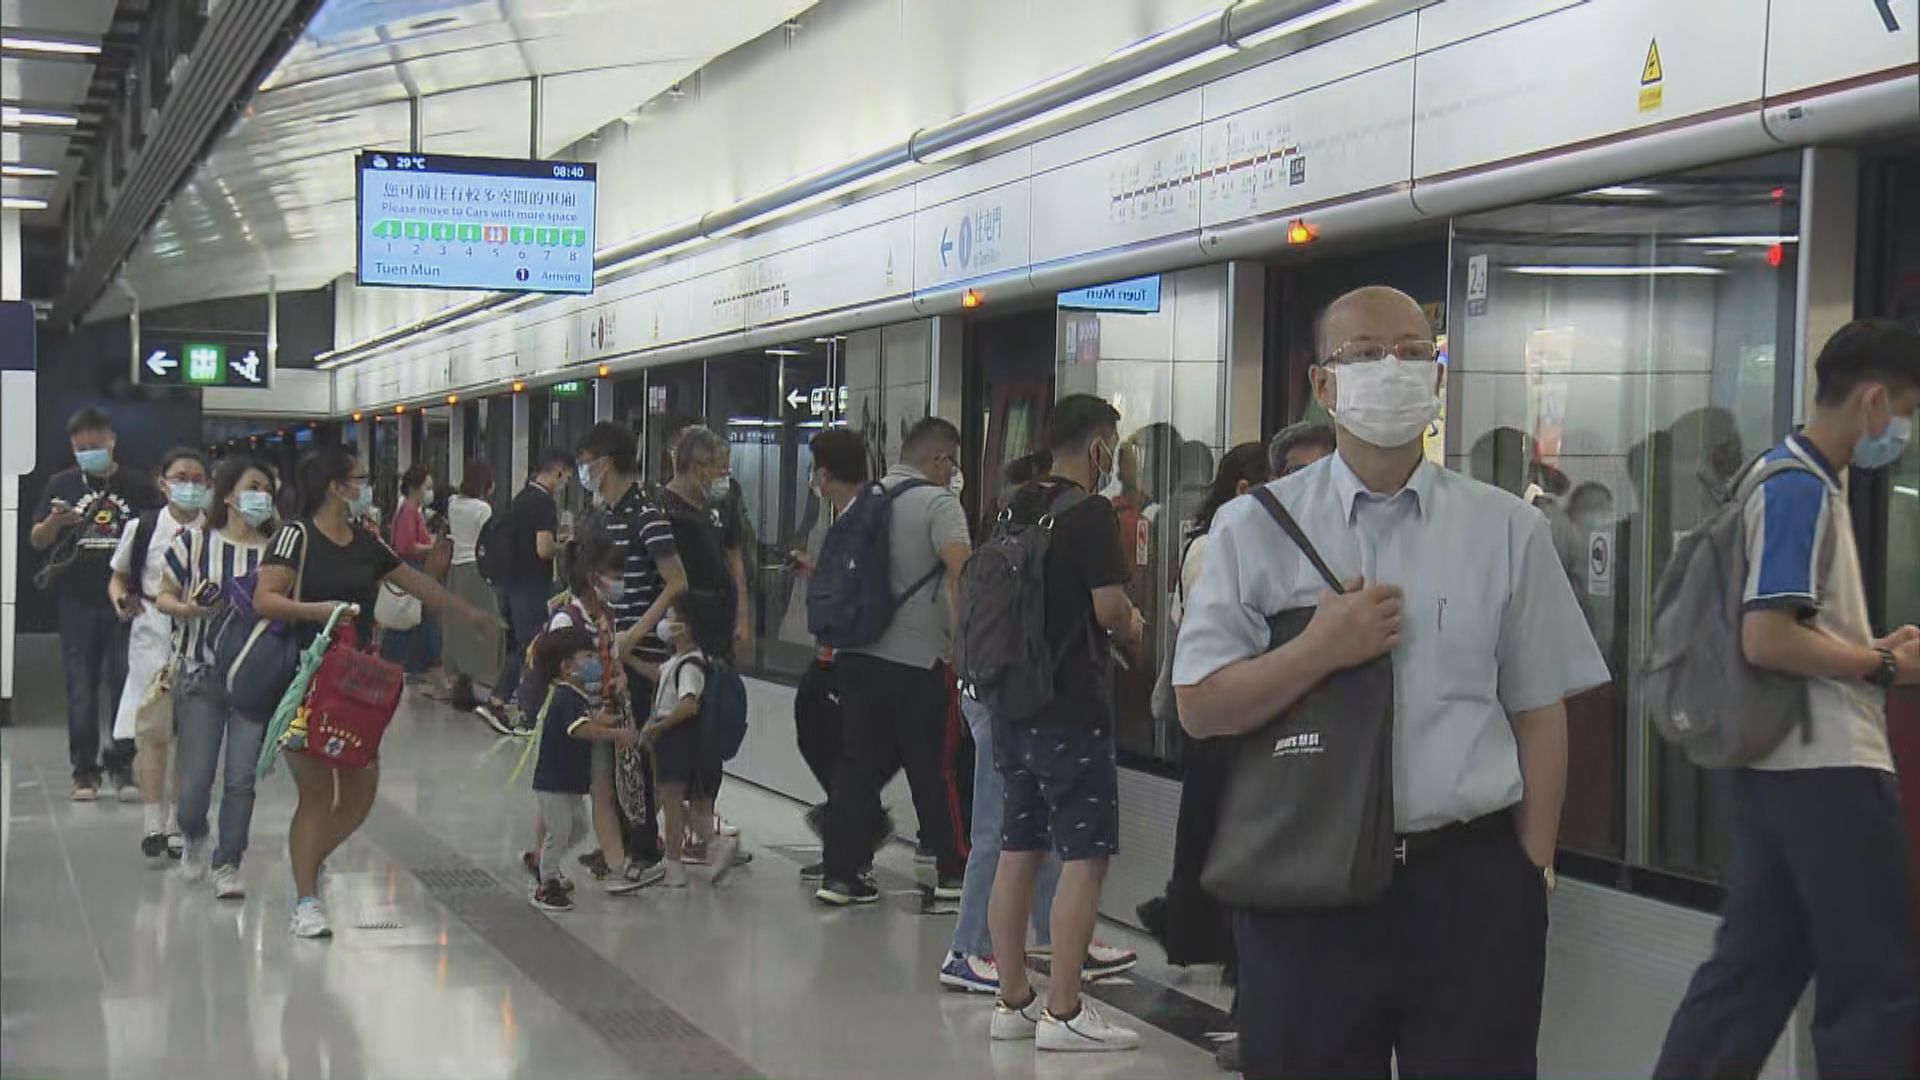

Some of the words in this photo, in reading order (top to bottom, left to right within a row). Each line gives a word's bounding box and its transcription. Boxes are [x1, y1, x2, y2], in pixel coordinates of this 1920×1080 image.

[553, 166, 584, 178] 08:40
[382, 201, 416, 214] Please
[419, 206, 449, 216] move
[452, 206, 463, 217] to
[466, 205, 488, 217] Cars
[491, 207, 515, 218] with
[517, 210, 545, 220] more
[548, 211, 577, 223] space
[376, 262, 408, 275] Tuen
[411, 263, 440, 277] Mun
[542, 271, 581, 283] Arriving
